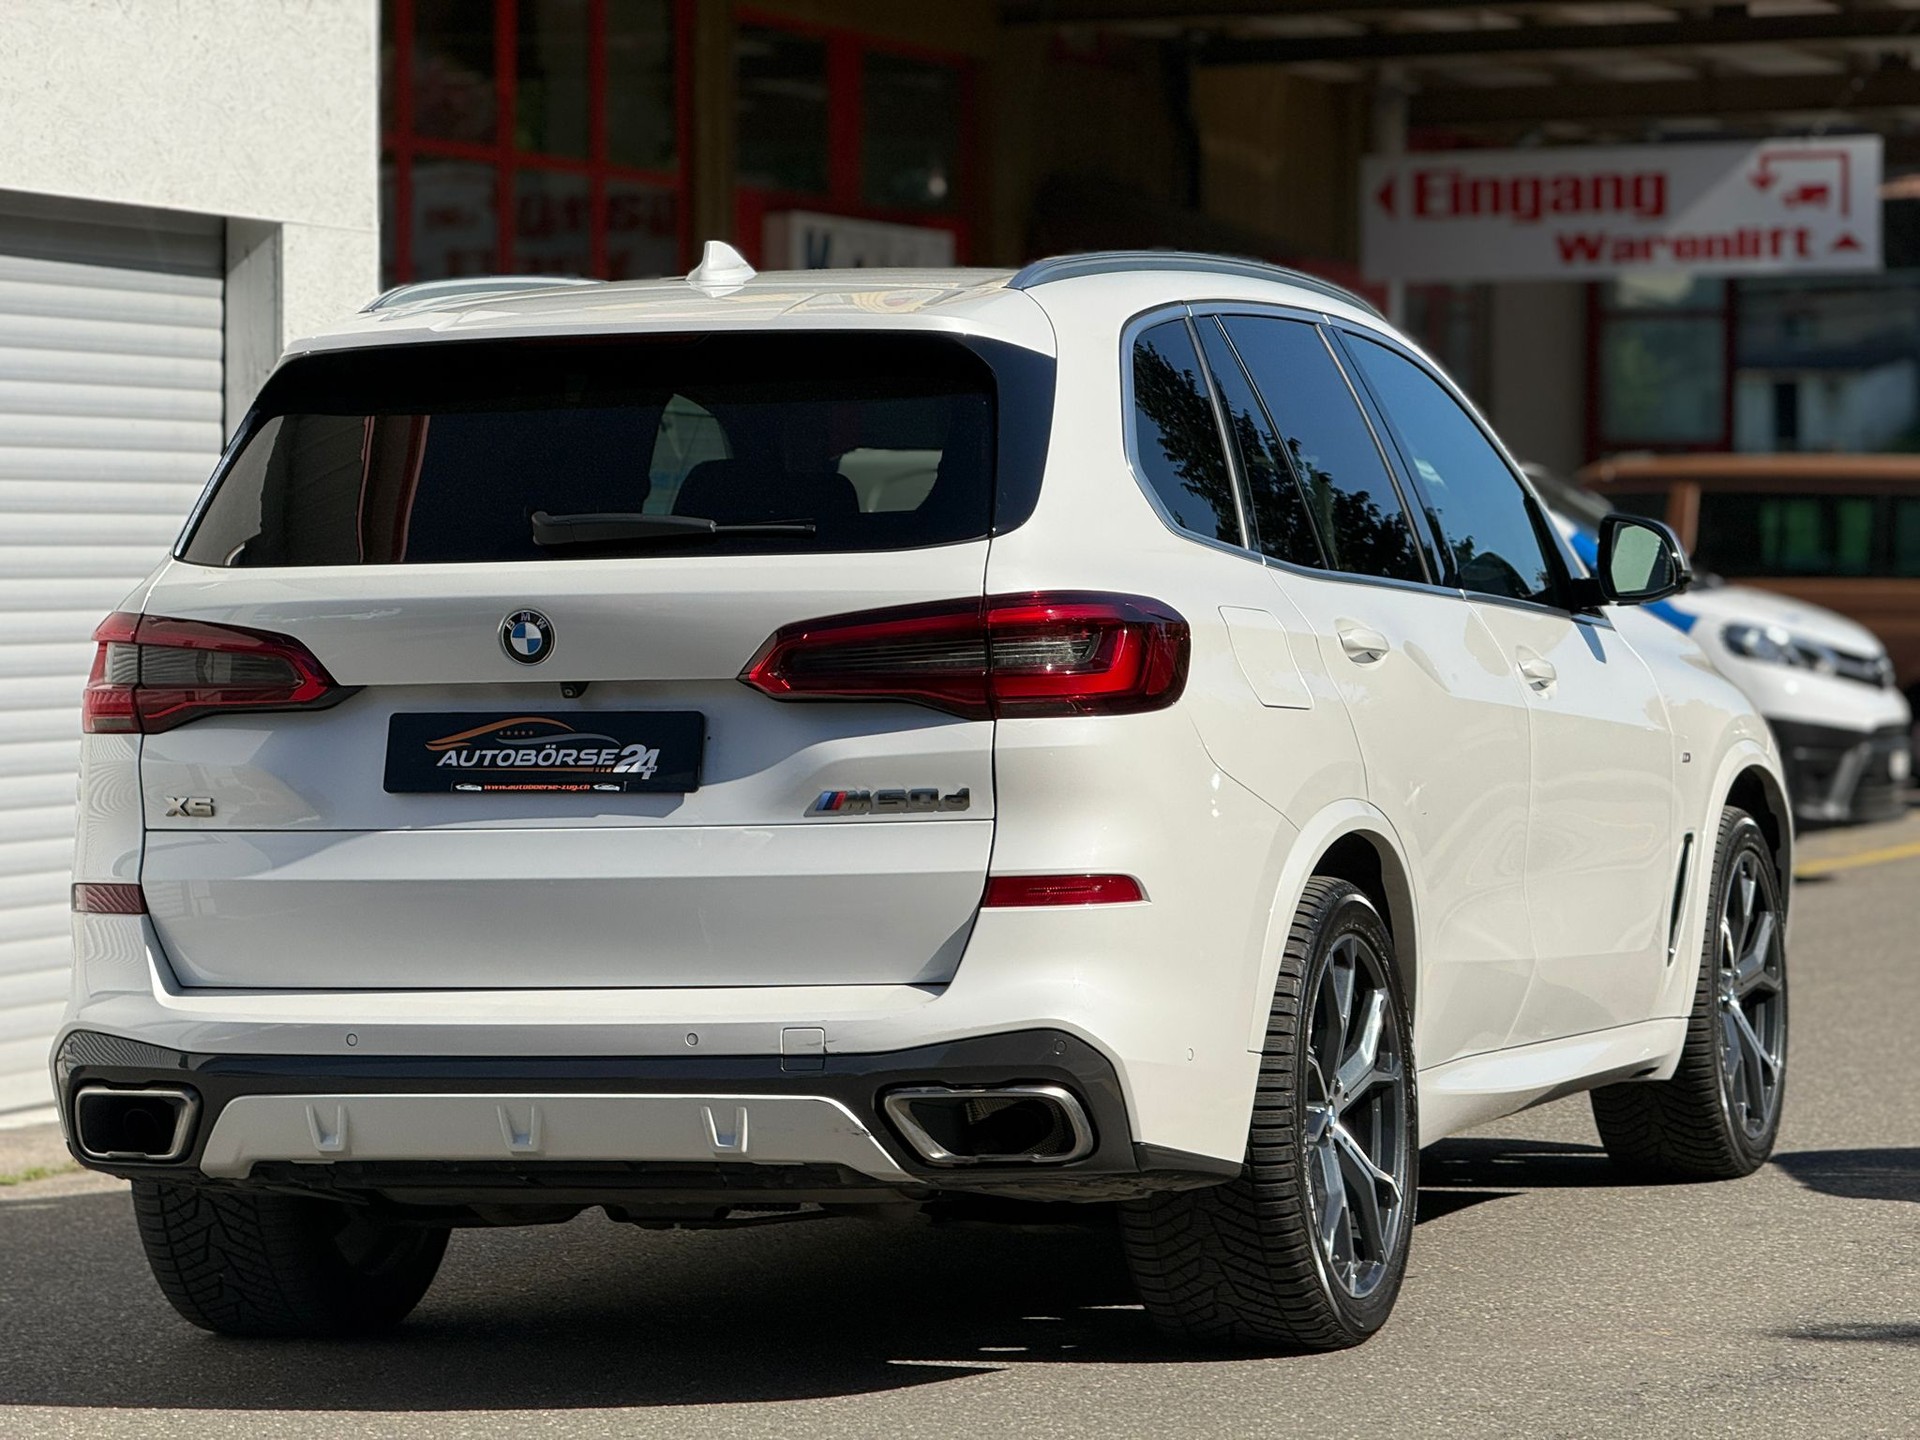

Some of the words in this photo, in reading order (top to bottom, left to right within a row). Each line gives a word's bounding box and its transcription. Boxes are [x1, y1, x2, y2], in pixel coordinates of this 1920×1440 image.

[1414, 168, 1669, 224] Eingang
[1555, 227, 1815, 265] Warenlift
[505, 612, 548, 630] BMW
[165, 797, 215, 817] X5
[820, 787, 970, 816] M50d
